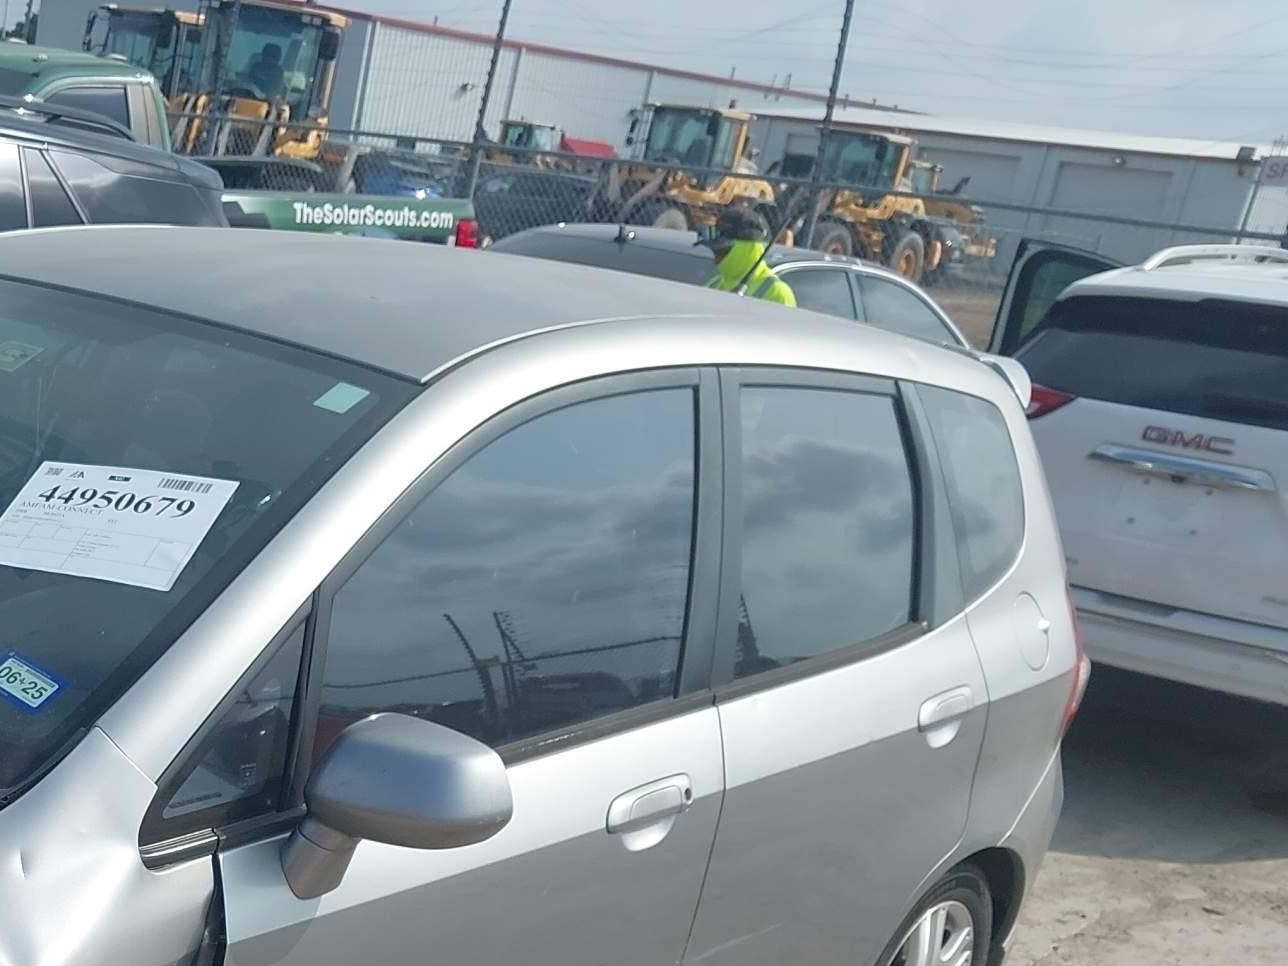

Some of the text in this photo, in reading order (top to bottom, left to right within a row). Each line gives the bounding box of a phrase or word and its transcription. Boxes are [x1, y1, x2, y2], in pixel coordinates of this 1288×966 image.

[293, 202, 453, 228] TheSolarScouts.com
[1142, 425, 1235, 455] GMC
[38, 484, 195, 518] 44950679
